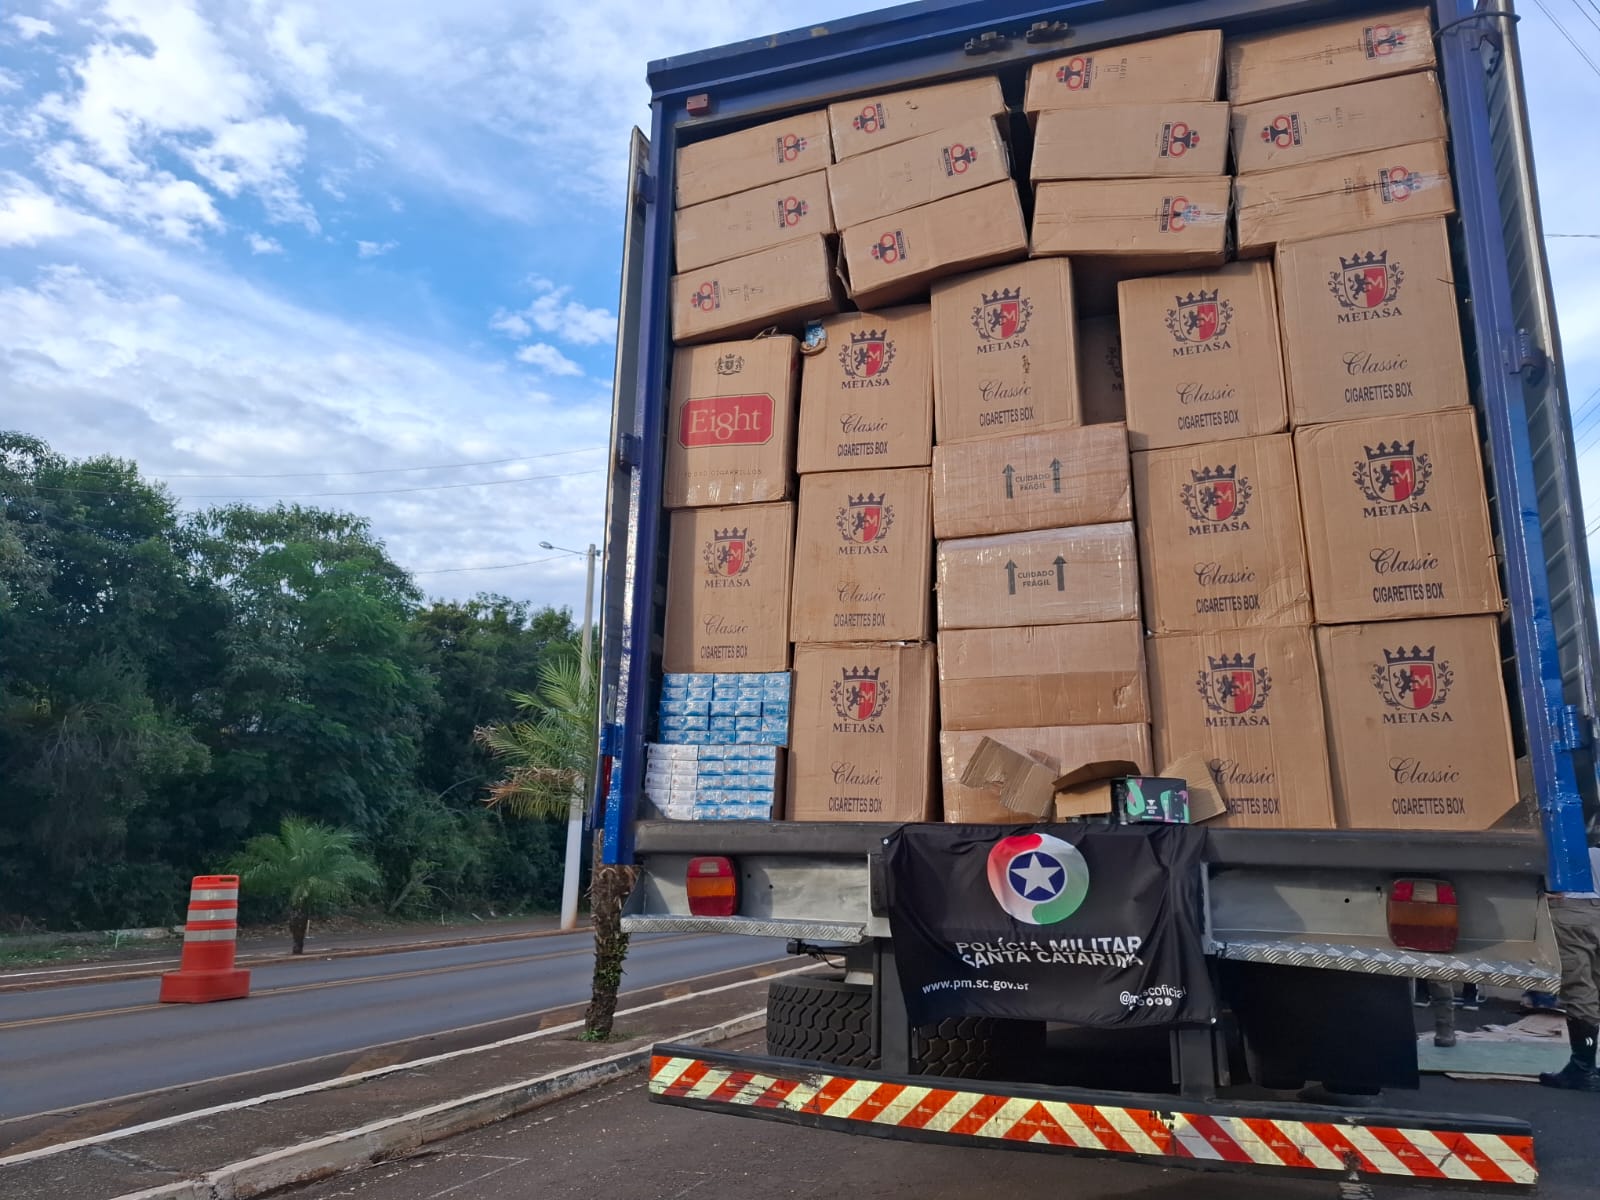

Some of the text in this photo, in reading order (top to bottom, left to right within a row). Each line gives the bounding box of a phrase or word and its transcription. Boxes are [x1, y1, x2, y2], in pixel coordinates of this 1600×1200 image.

[1337, 307, 1402, 324] METASA
[976, 338, 1031, 355] METASA
[1172, 340, 1232, 358] METASA
[1343, 351, 1407, 376] Classic
[841, 377, 891, 390] METASA
[978, 379, 1032, 402] Classic
[1345, 381, 1413, 403] CIGARETTES BOX
[1176, 383, 1235, 405] Classic
[689, 405, 761, 439] Eight
[840, 414, 888, 434] Classic
[980, 406, 1034, 427] CIGARETTES BOX
[1178, 409, 1239, 430] CIGARETTES BOX
[837, 441, 888, 456] CIGARETTES BOX
[1015, 472, 1050, 484] CUIDADO
[1362, 502, 1433, 519] METASA
[1188, 520, 1252, 536] METASA
[838, 545, 889, 556] METASA
[1368, 546, 1440, 575] Classic
[704, 578, 751, 589] METASA
[1018, 569, 1055, 580] CUIDADO
[1193, 562, 1255, 587] Classic
[836, 579, 886, 603] Classic
[1373, 582, 1444, 603] CIGARETTES BOX
[1194, 593, 1260, 615] CIGARETTES BOX
[703, 614, 749, 636] Classic
[834, 613, 885, 627] CIGARETTES BOX
[701, 645, 748, 659] CIGARETTES BOX
[1204, 714, 1271, 729] METASA
[1382, 710, 1455, 725] METASA
[832, 722, 885, 734] METASA
[830, 760, 883, 787] Classic
[1208, 758, 1275, 785] Classic
[1387, 756, 1460, 785] Classic
[829, 797, 883, 814] CIGARETTES BOX
[1224, 797, 1280, 816] ARETTES BOX
[1391, 797, 1465, 816] CIGARETTES BOX
[955, 935, 1143, 955] POLÍCIA MILITAR
[961, 951, 1144, 969] SANTA CATARINA
[922, 979, 1029, 994] www.pm.sc.gov.br
